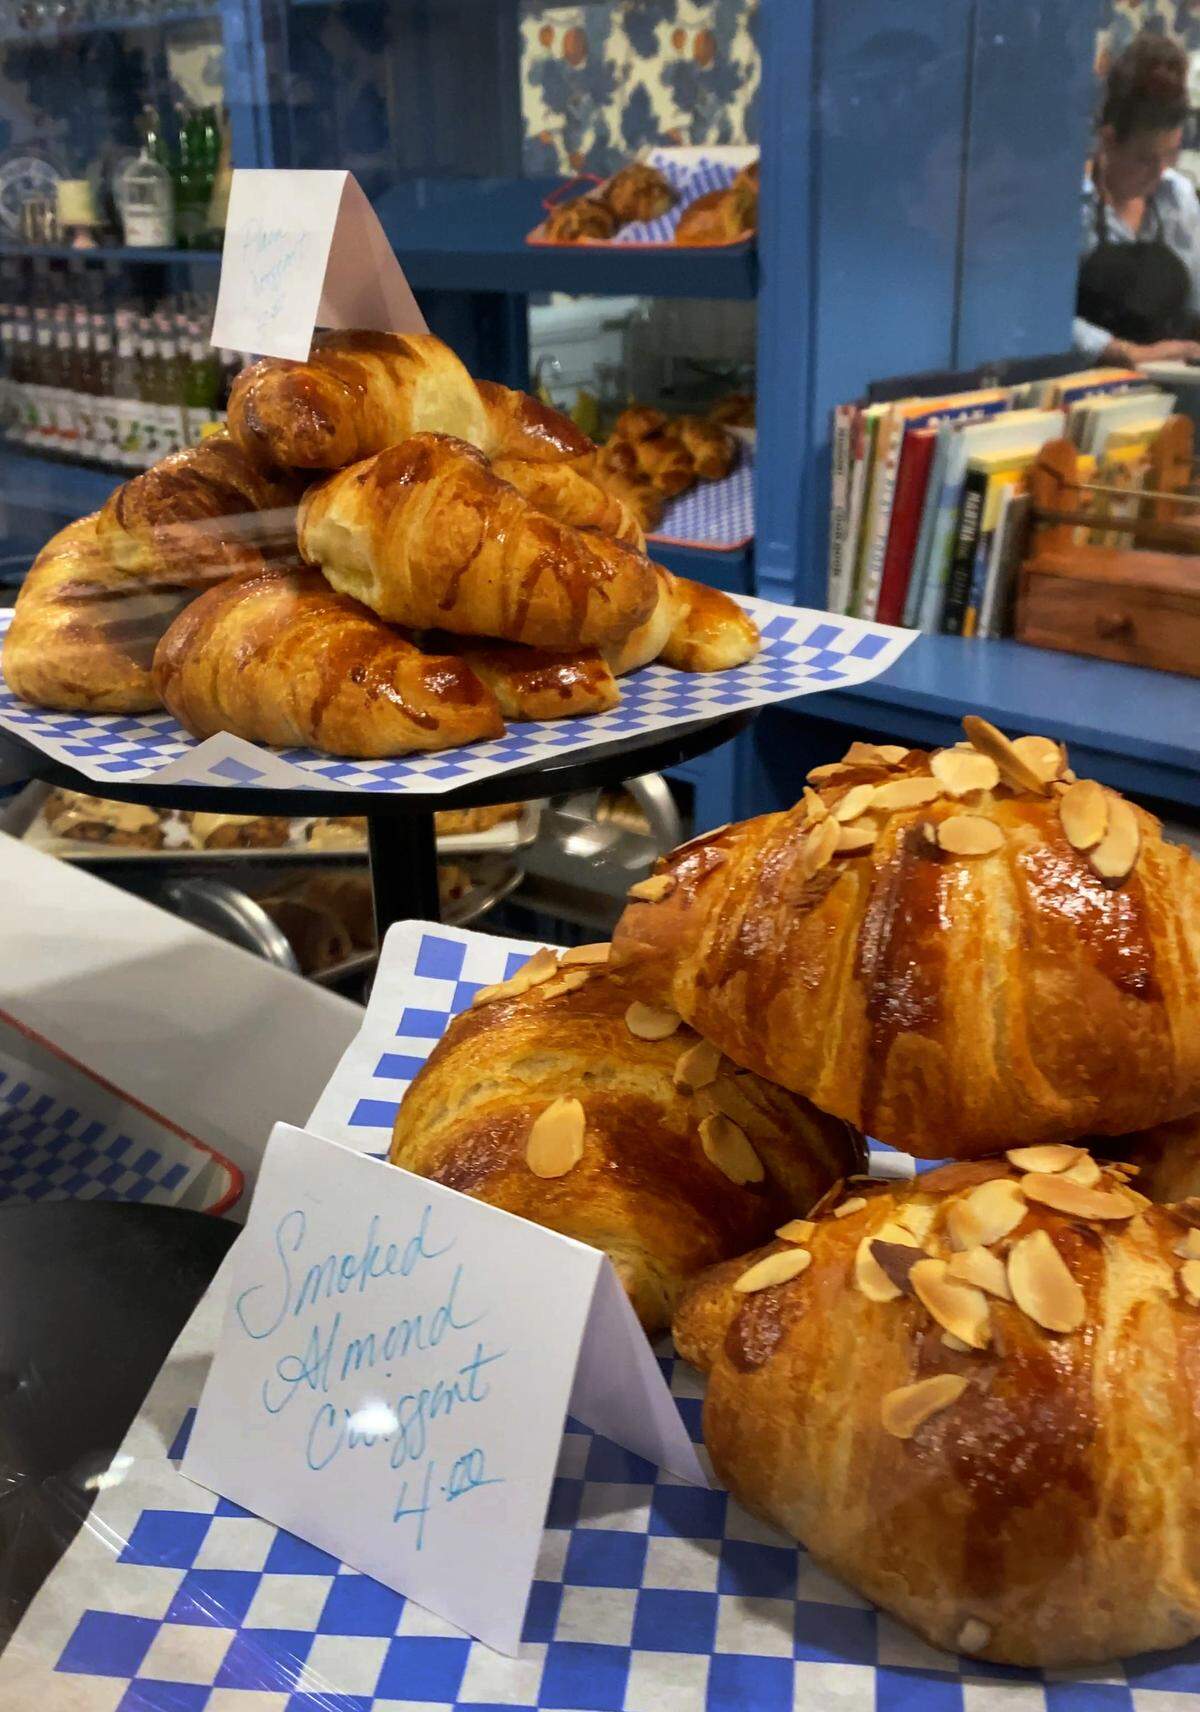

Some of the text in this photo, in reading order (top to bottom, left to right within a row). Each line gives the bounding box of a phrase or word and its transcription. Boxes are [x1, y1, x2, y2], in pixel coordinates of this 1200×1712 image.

[237, 1205, 454, 1339] Smoked
[263, 1265, 487, 1413] Almond
[307, 1342, 505, 1471] Crssant
